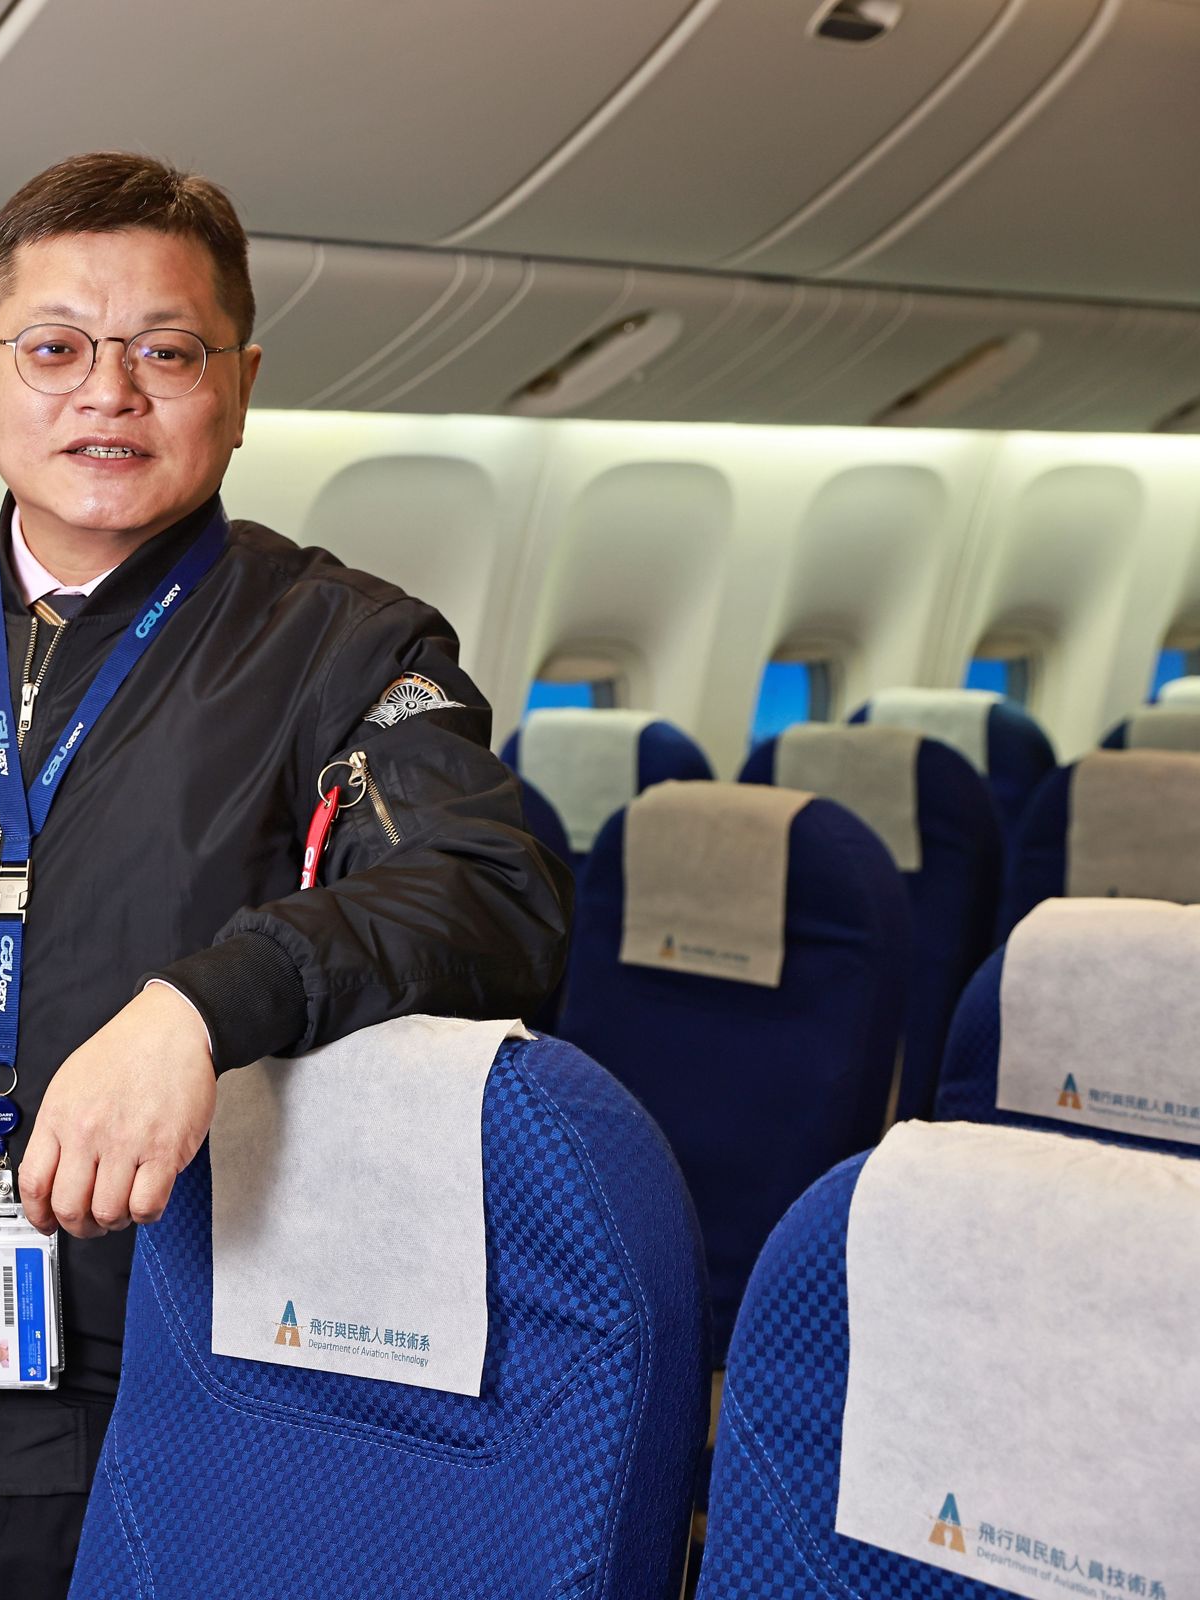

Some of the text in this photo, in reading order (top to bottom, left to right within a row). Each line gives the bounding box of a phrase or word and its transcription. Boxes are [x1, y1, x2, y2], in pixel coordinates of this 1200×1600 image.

[309, 1318, 431, 1352] 飛行與民航人員技術系
[308, 1338, 429, 1368] Department of Aviation Technology
[978, 1521, 1167, 1600] 飛行與民航人員技術系
